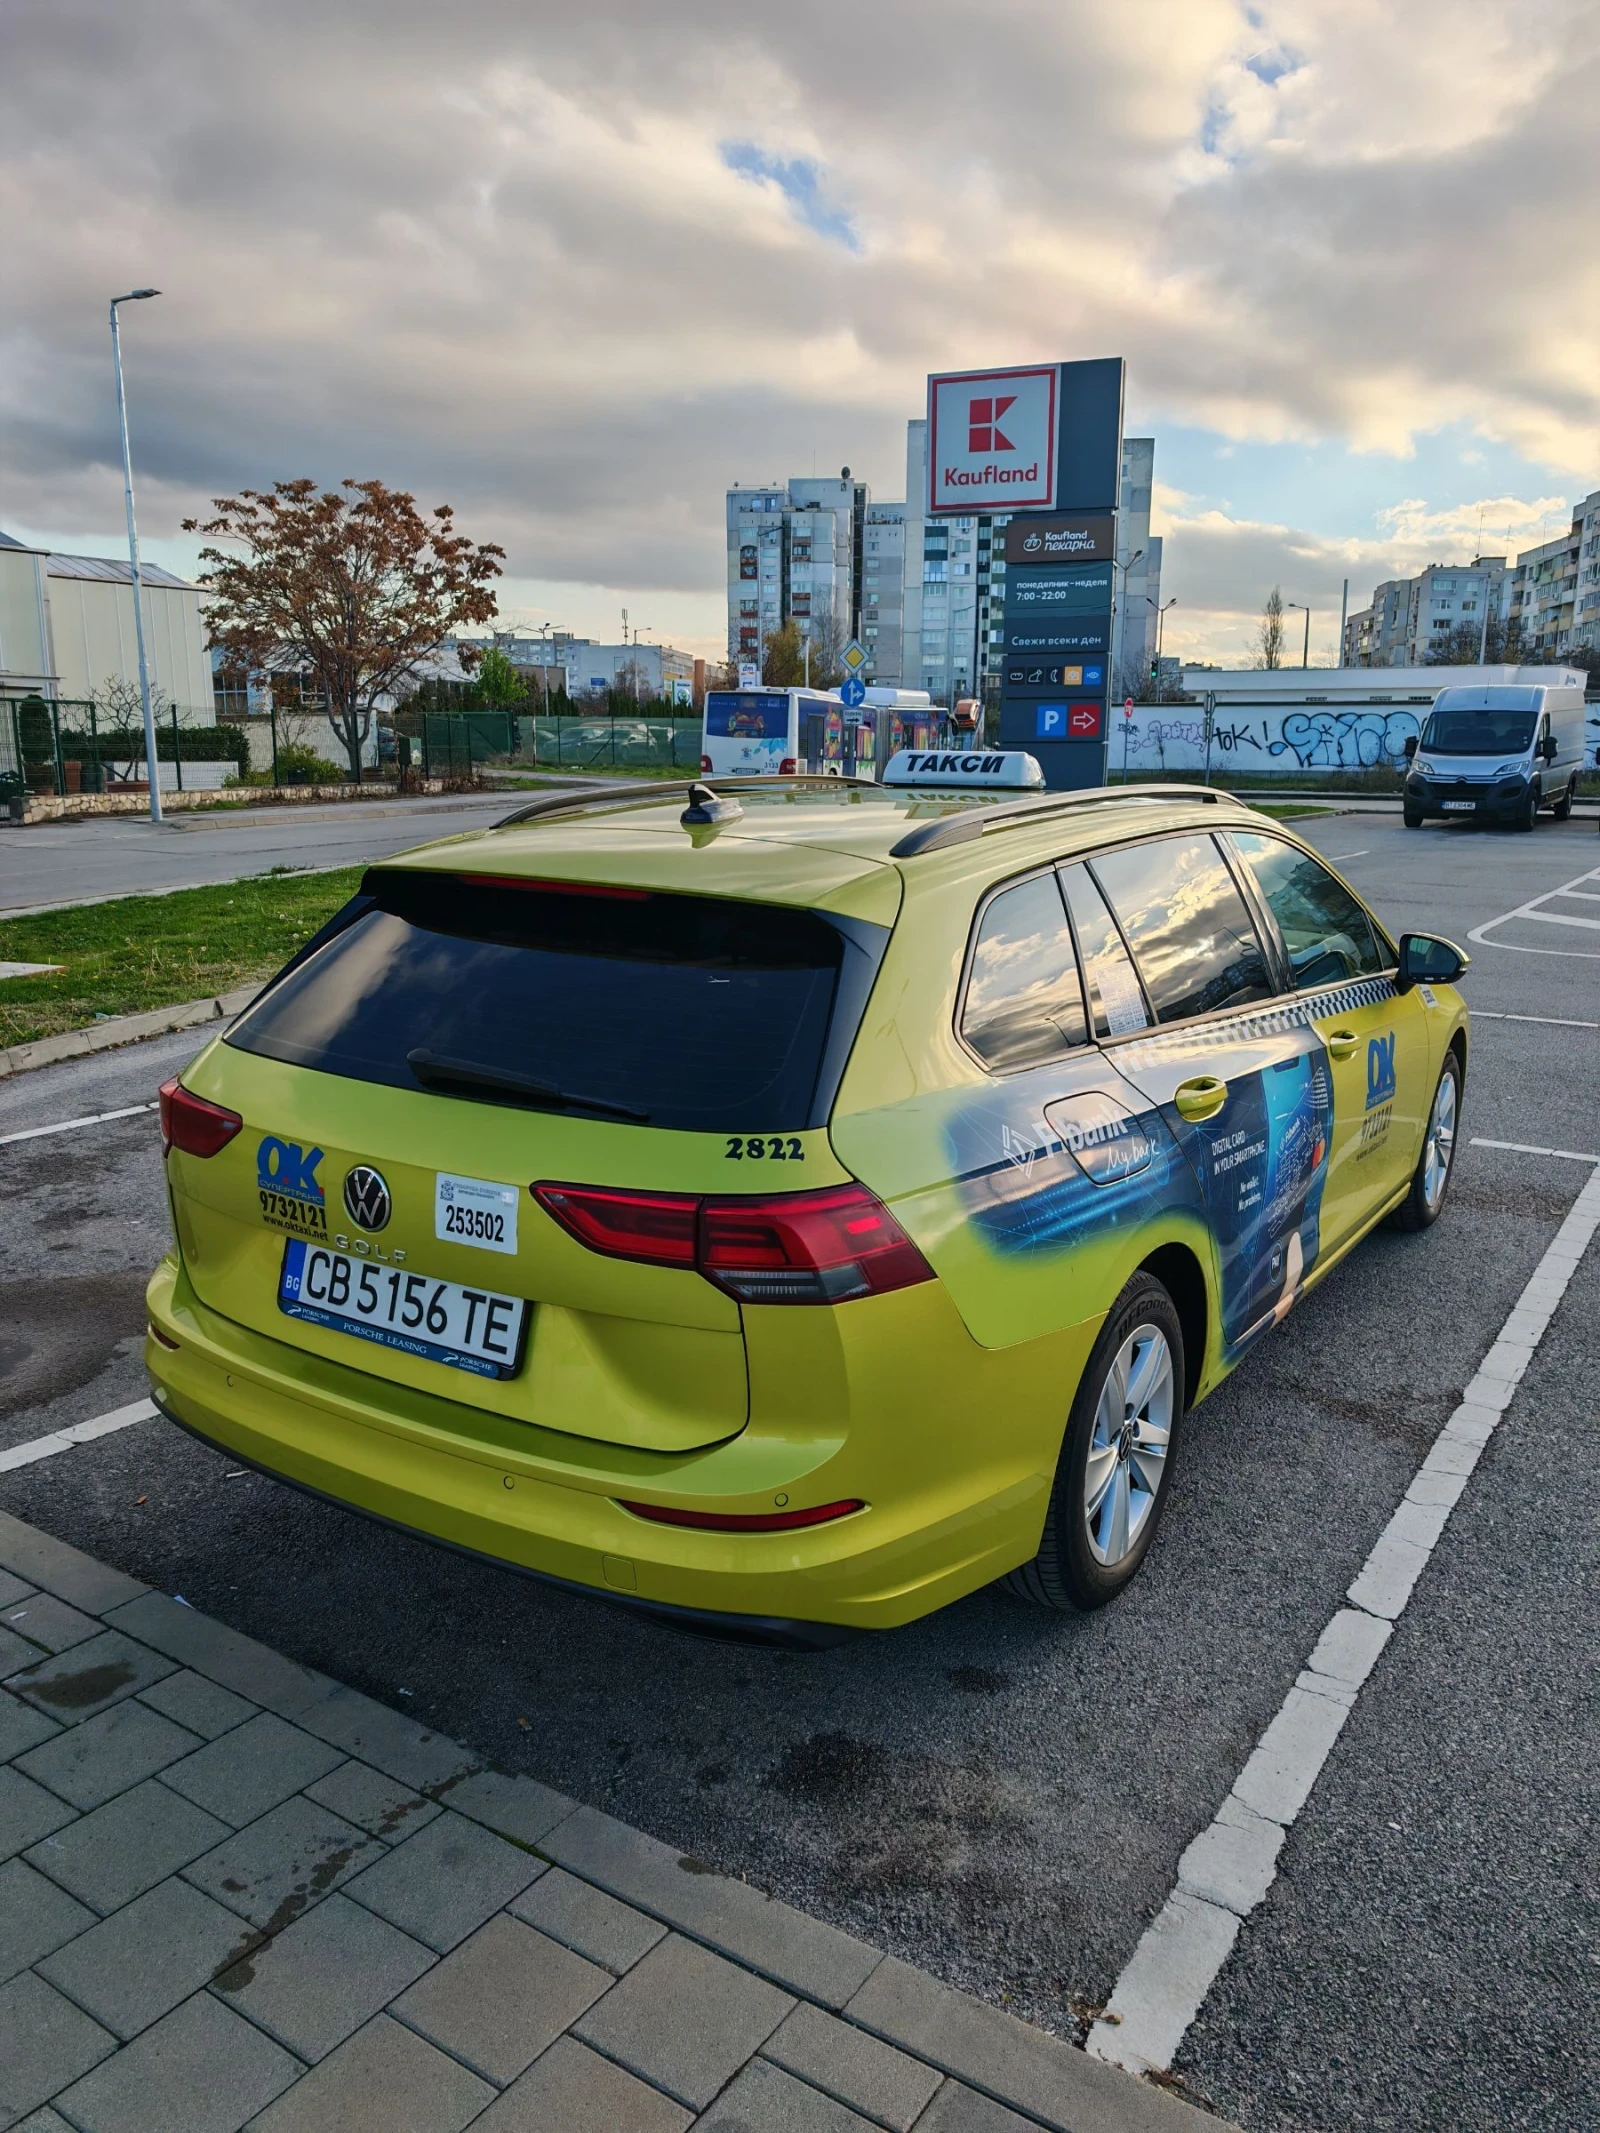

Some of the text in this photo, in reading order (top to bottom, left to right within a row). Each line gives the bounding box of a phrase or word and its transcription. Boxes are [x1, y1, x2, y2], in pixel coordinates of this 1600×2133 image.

[945, 463, 1038, 486] Kaufland
[1044, 540, 1096, 552] пекарна
[1045, 530, 1087, 541] Kaufland
[1012, 636, 1101, 646] Свежи всеки ден
[907, 754, 1005, 773] ТАКСИ
[1031, 1103, 1128, 1159] Fibank
[1211, 1130, 1246, 1156] DIGITAL CARD
[725, 1137, 805, 1161] 2822
[1213, 1139, 1266, 1176] IN YOUR SMARTPHONE
[1106, 1146, 1132, 1178] My
[260, 1180, 323, 1203] СУПЕРТРАНС
[260, 1190, 327, 1230] 9732121
[263, 1214, 329, 1241] www.oktaxi.net
[446, 1205, 504, 1243] 253502
[334, 1233, 407, 1263] GOLF
[286, 1275, 300, 1291] BG
[302, 1308, 330, 1321] PORSCHE
[357, 1263, 448, 1334] 5156
[462, 1290, 513, 1355] TE
[343, 1322, 427, 1354] PORSCHE LEASING
[460, 1356, 492, 1370] PORSCHE
